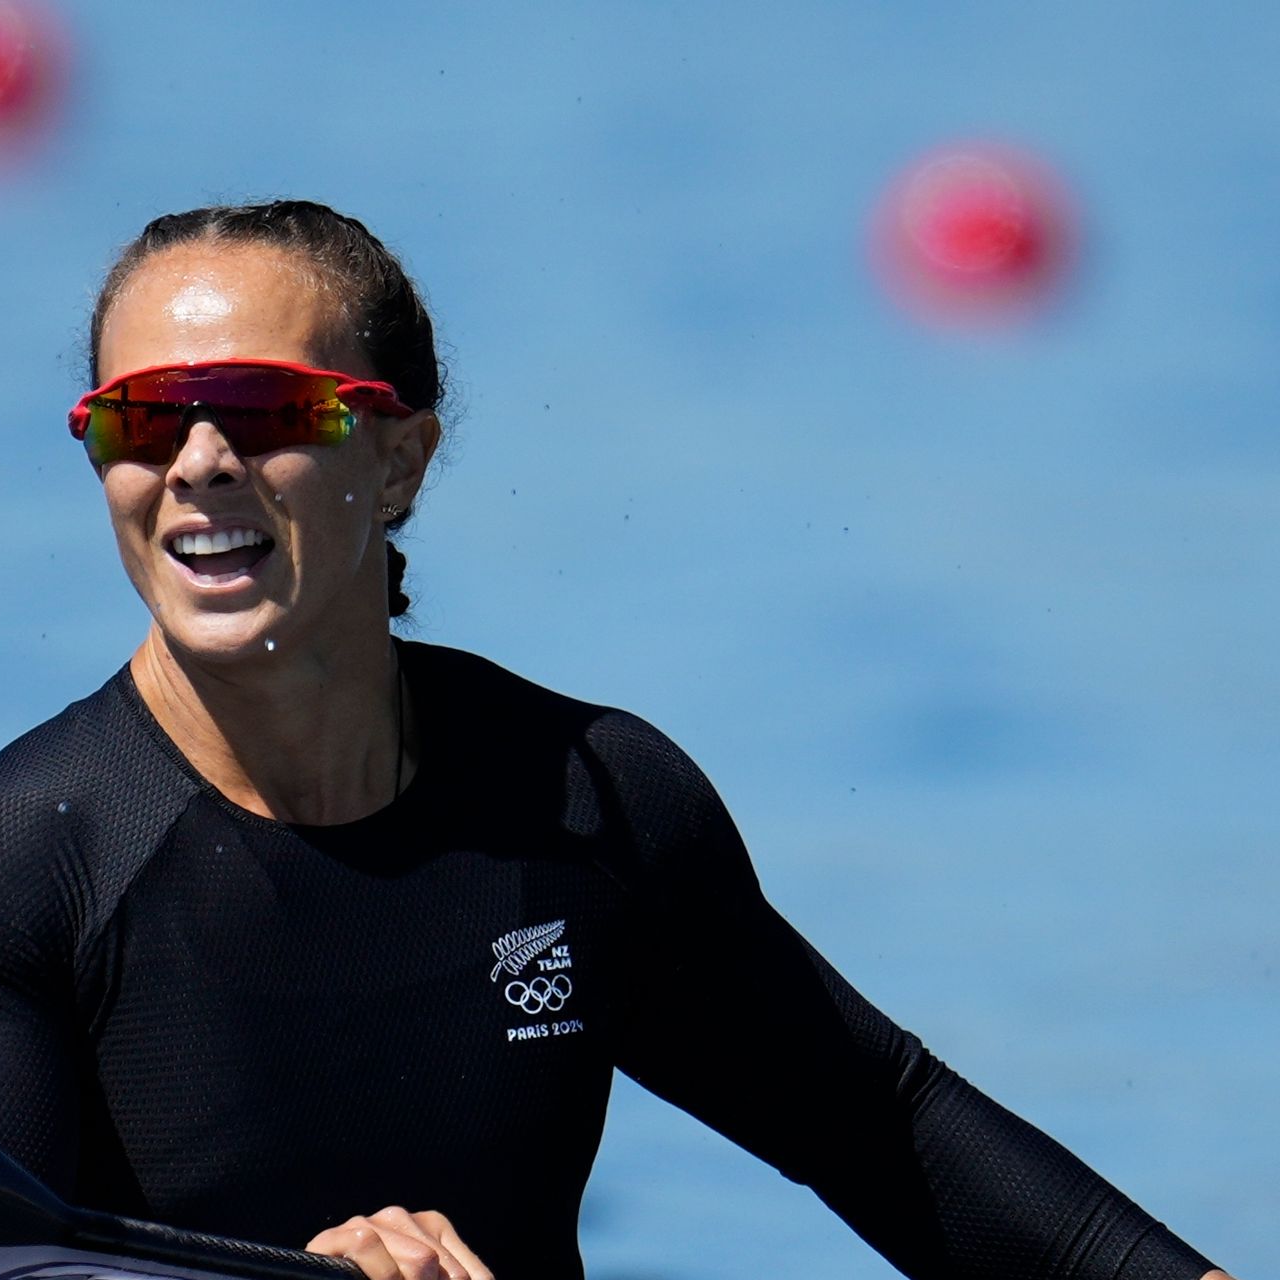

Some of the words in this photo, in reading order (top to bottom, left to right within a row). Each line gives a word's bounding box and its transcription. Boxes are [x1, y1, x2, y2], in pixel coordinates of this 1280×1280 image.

[552, 945, 570, 958] NZ
[537, 957, 572, 971] TEAM
[507, 1024, 549, 1042] PARIS
[552, 1019, 584, 1036] 2024
